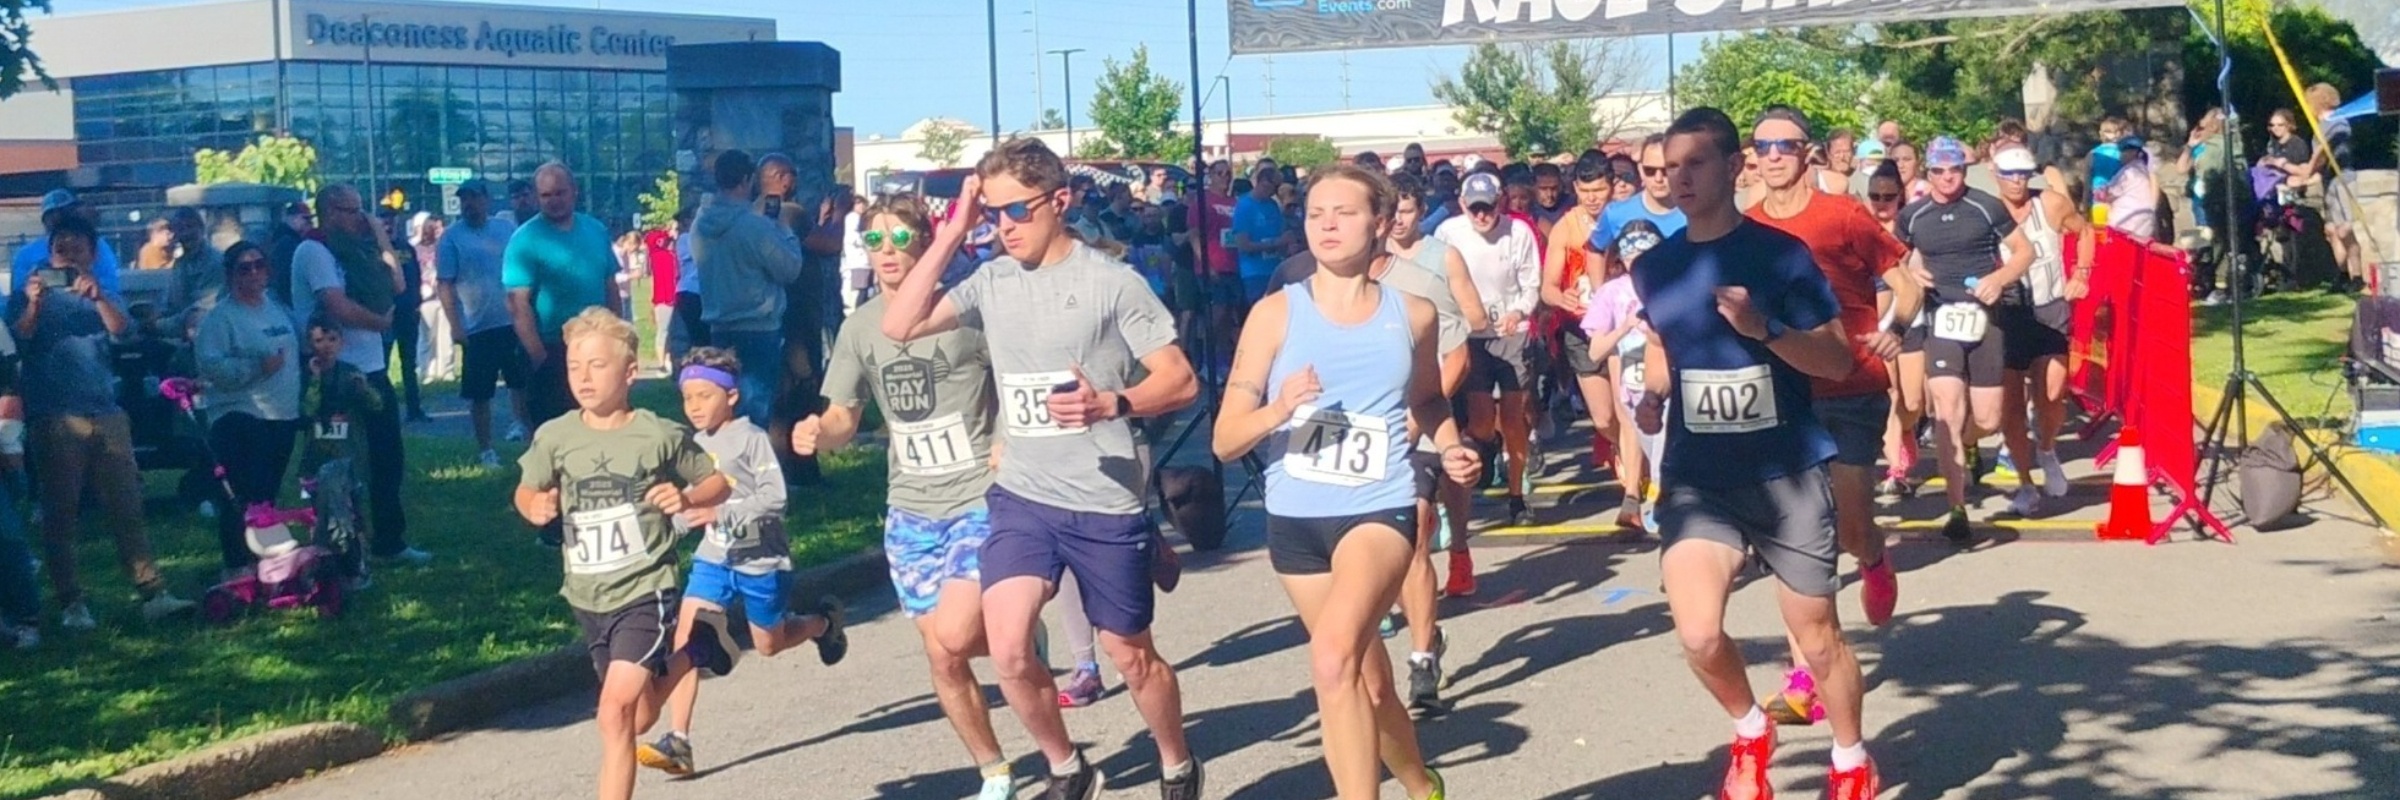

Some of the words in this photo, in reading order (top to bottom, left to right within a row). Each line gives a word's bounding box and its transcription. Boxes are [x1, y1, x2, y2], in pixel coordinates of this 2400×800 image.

[306, 13, 469, 50] Deaconess
[474, 20, 583, 58] Aquatic
[1945, 311, 1978, 336] 577
[886, 378, 926, 397] DAY
[889, 394, 930, 412] RUN
[1696, 382, 1761, 421] 402
[906, 430, 957, 467] 411
[1302, 425, 1372, 475] 413
[574, 520, 630, 564] 574
